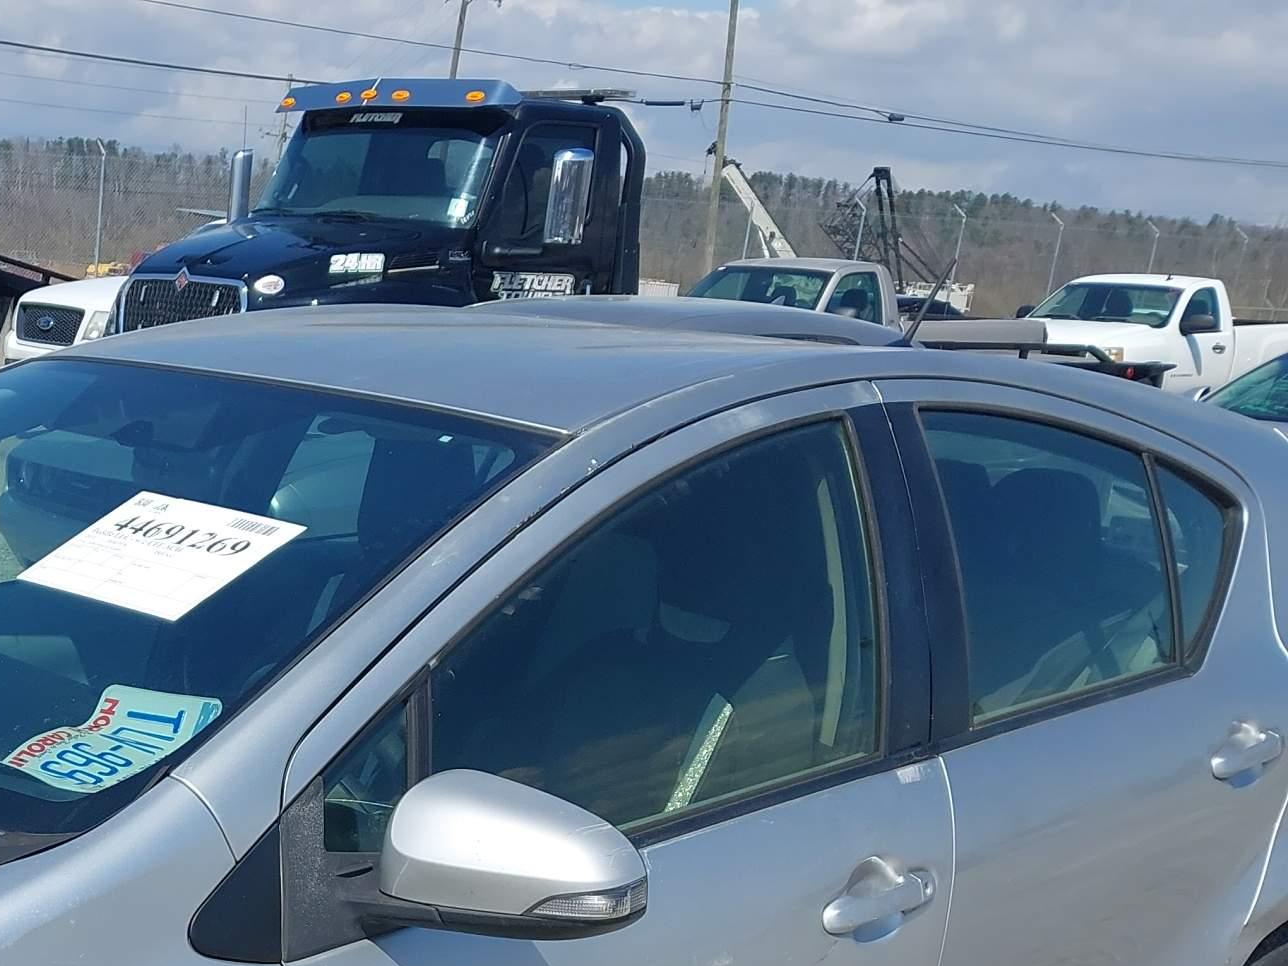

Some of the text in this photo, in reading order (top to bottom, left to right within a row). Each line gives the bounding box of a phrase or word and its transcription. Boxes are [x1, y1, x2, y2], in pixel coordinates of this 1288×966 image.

[491, 271, 576, 295] FLETCHER
[114, 515, 251, 556] 44691269
[86, 697, 120, 733] NOR
